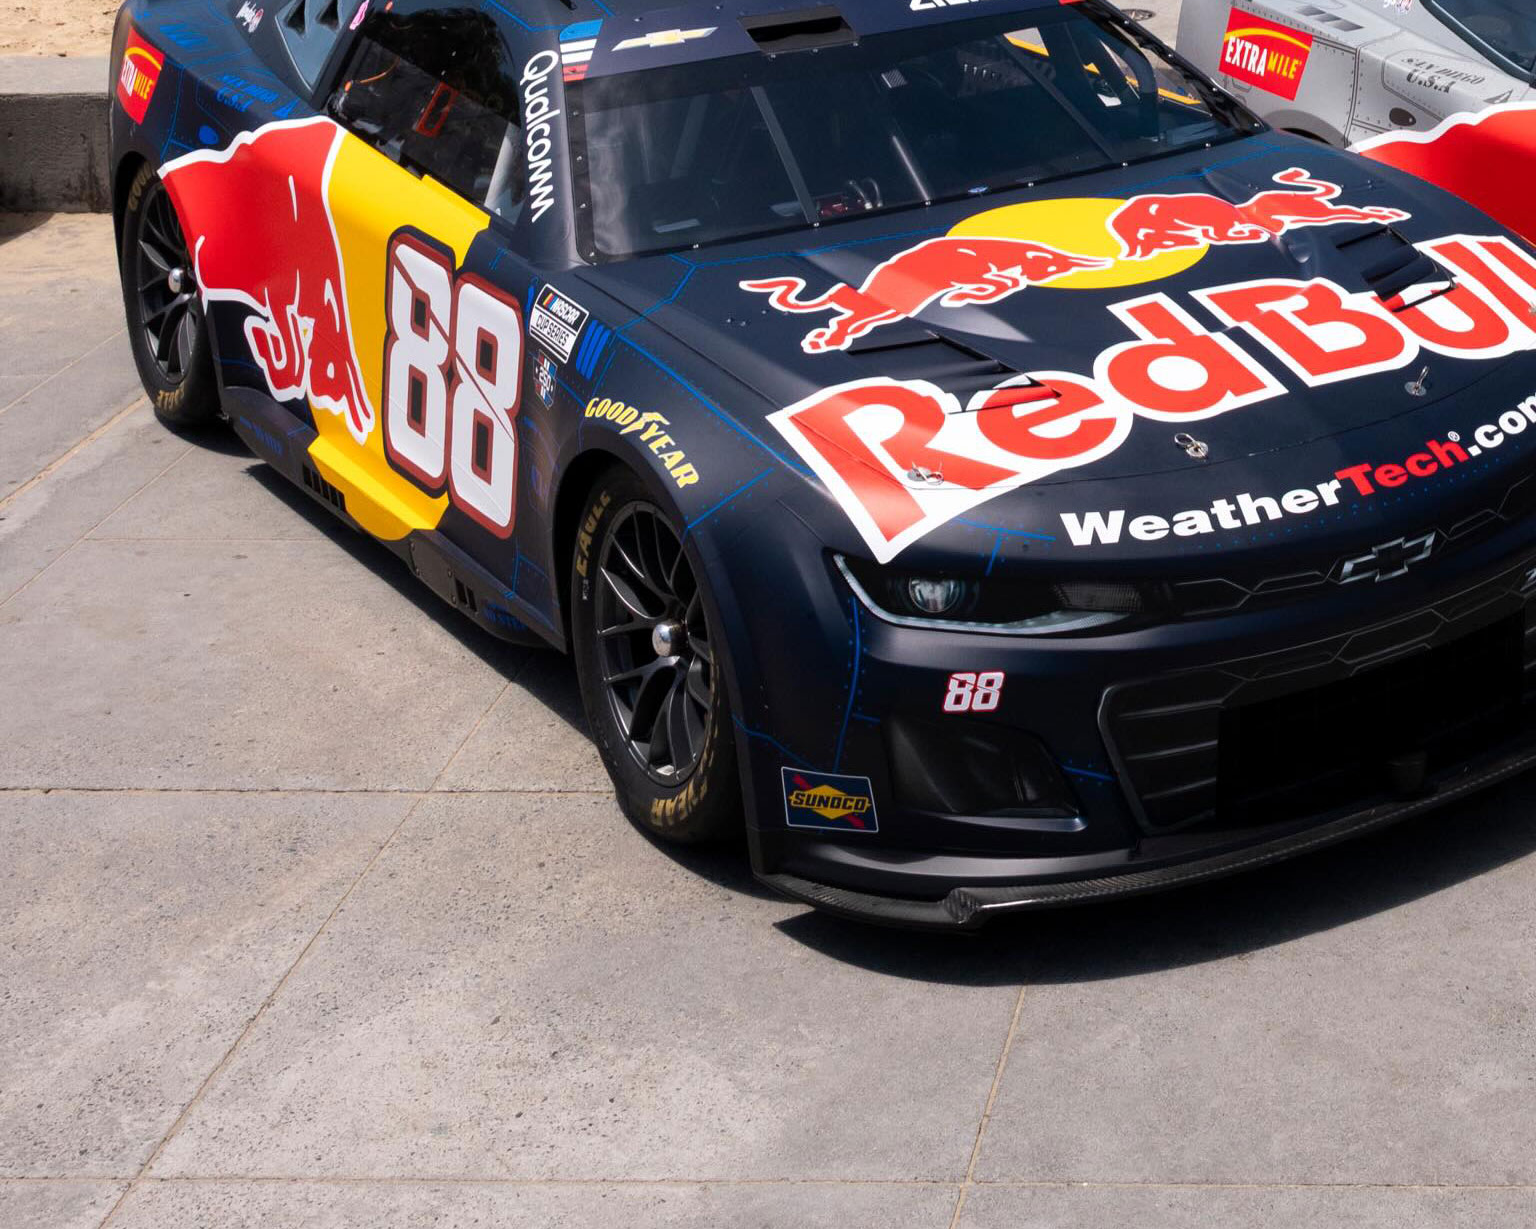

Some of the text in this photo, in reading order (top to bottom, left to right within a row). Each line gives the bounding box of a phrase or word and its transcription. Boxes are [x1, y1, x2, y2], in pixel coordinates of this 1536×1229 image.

[520, 50, 561, 223] Qualcomm
[549, 297, 581, 326] NASCAR
[535, 314, 570, 347] CUP SERIES
[388, 231, 525, 539] 88
[538, 368, 552, 387] 250
[584, 397, 699, 489] GOODYEAR
[943, 671, 1005, 712] 88
[791, 792, 867, 813] SUNOCO
